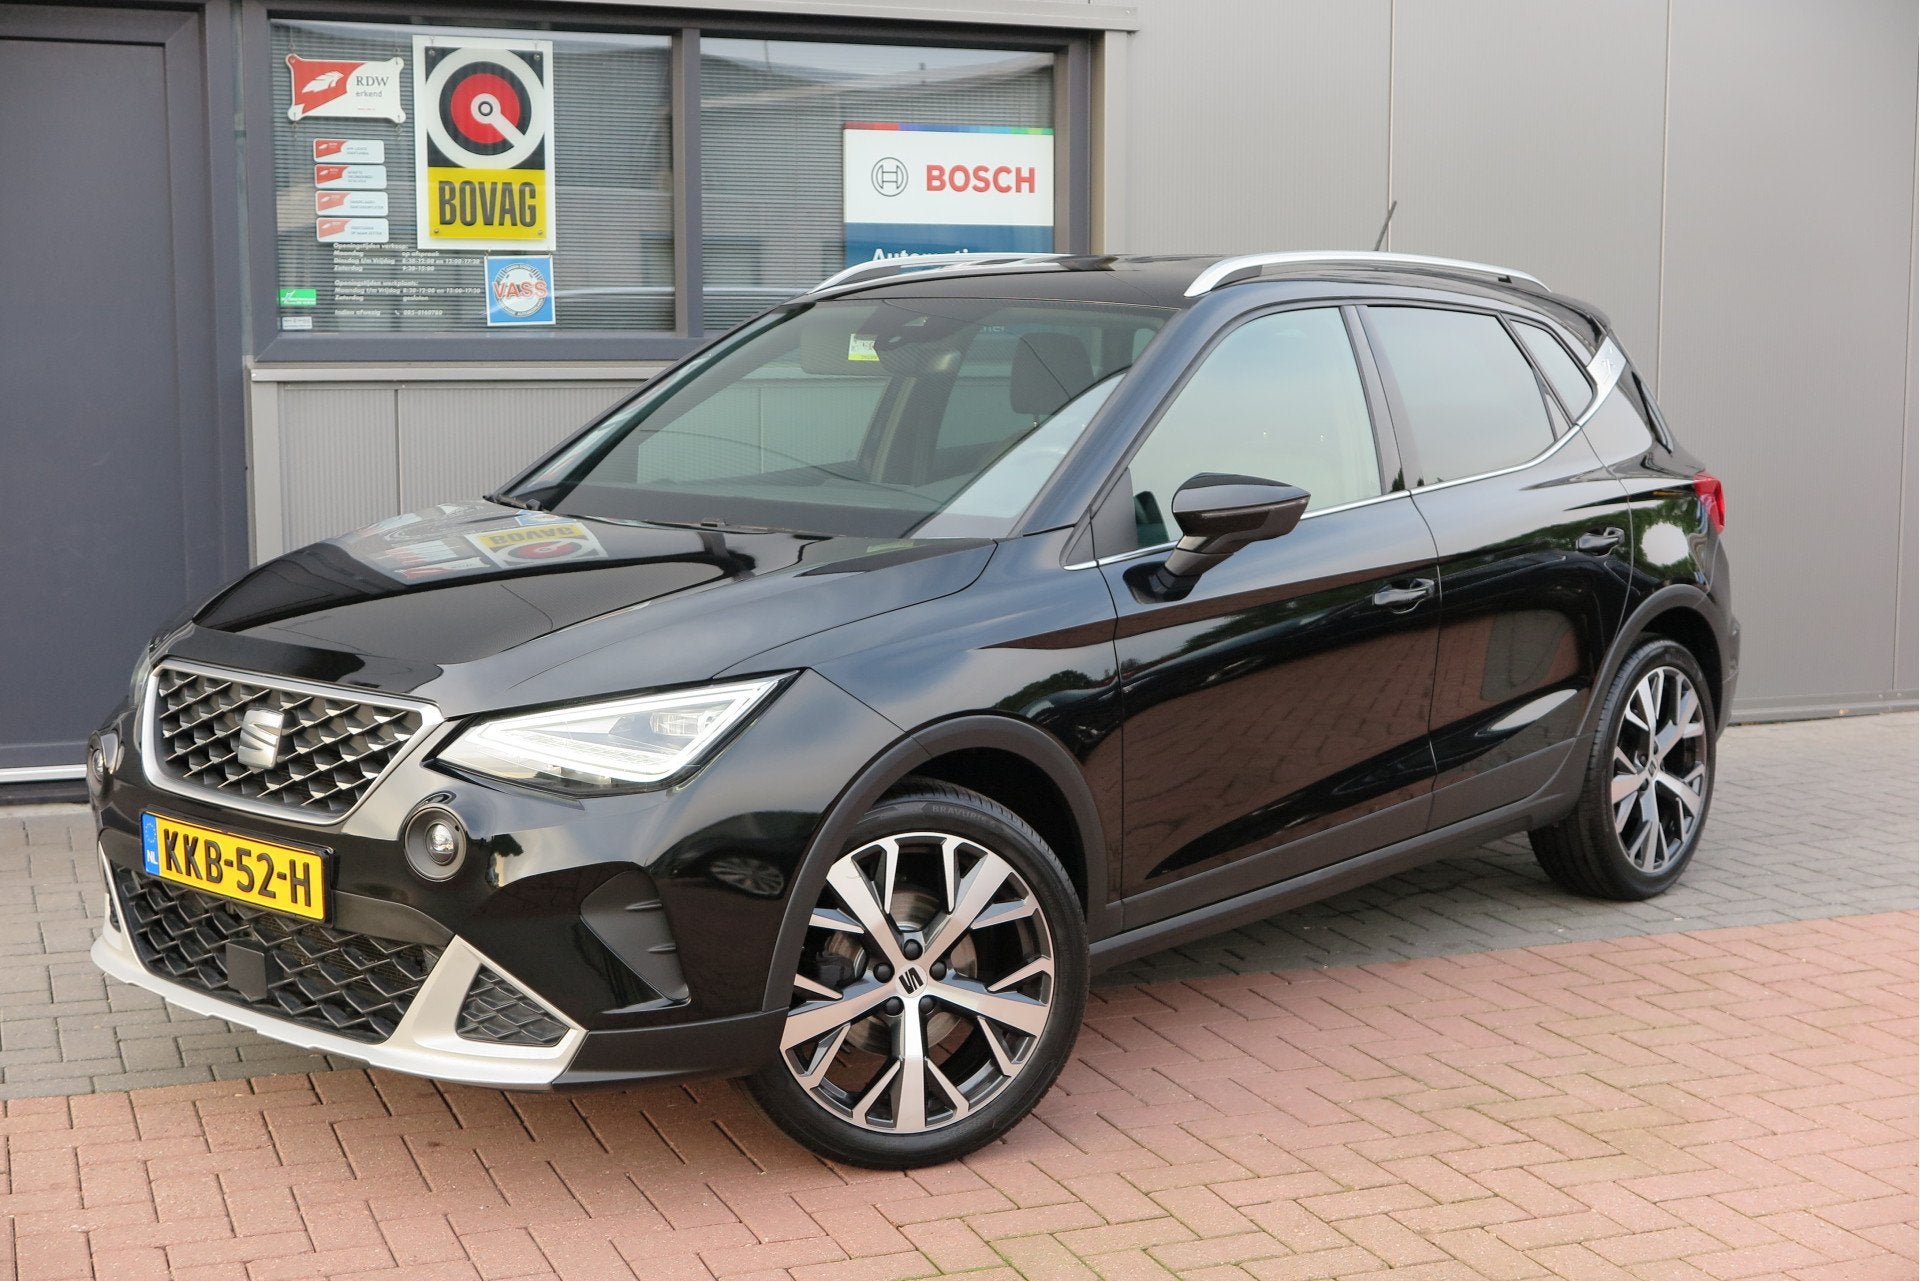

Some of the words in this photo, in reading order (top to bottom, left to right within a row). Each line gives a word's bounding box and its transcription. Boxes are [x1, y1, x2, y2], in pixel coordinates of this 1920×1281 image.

[356, 75, 390, 87] RDW
[355, 90, 383, 98] erkend
[926, 164, 1036, 194] BOSCH
[438, 180, 537, 228] BOVAG
[492, 280, 549, 299] VASS
[146, 850, 158, 865] NL
[163, 828, 311, 907] KKB-52-H
